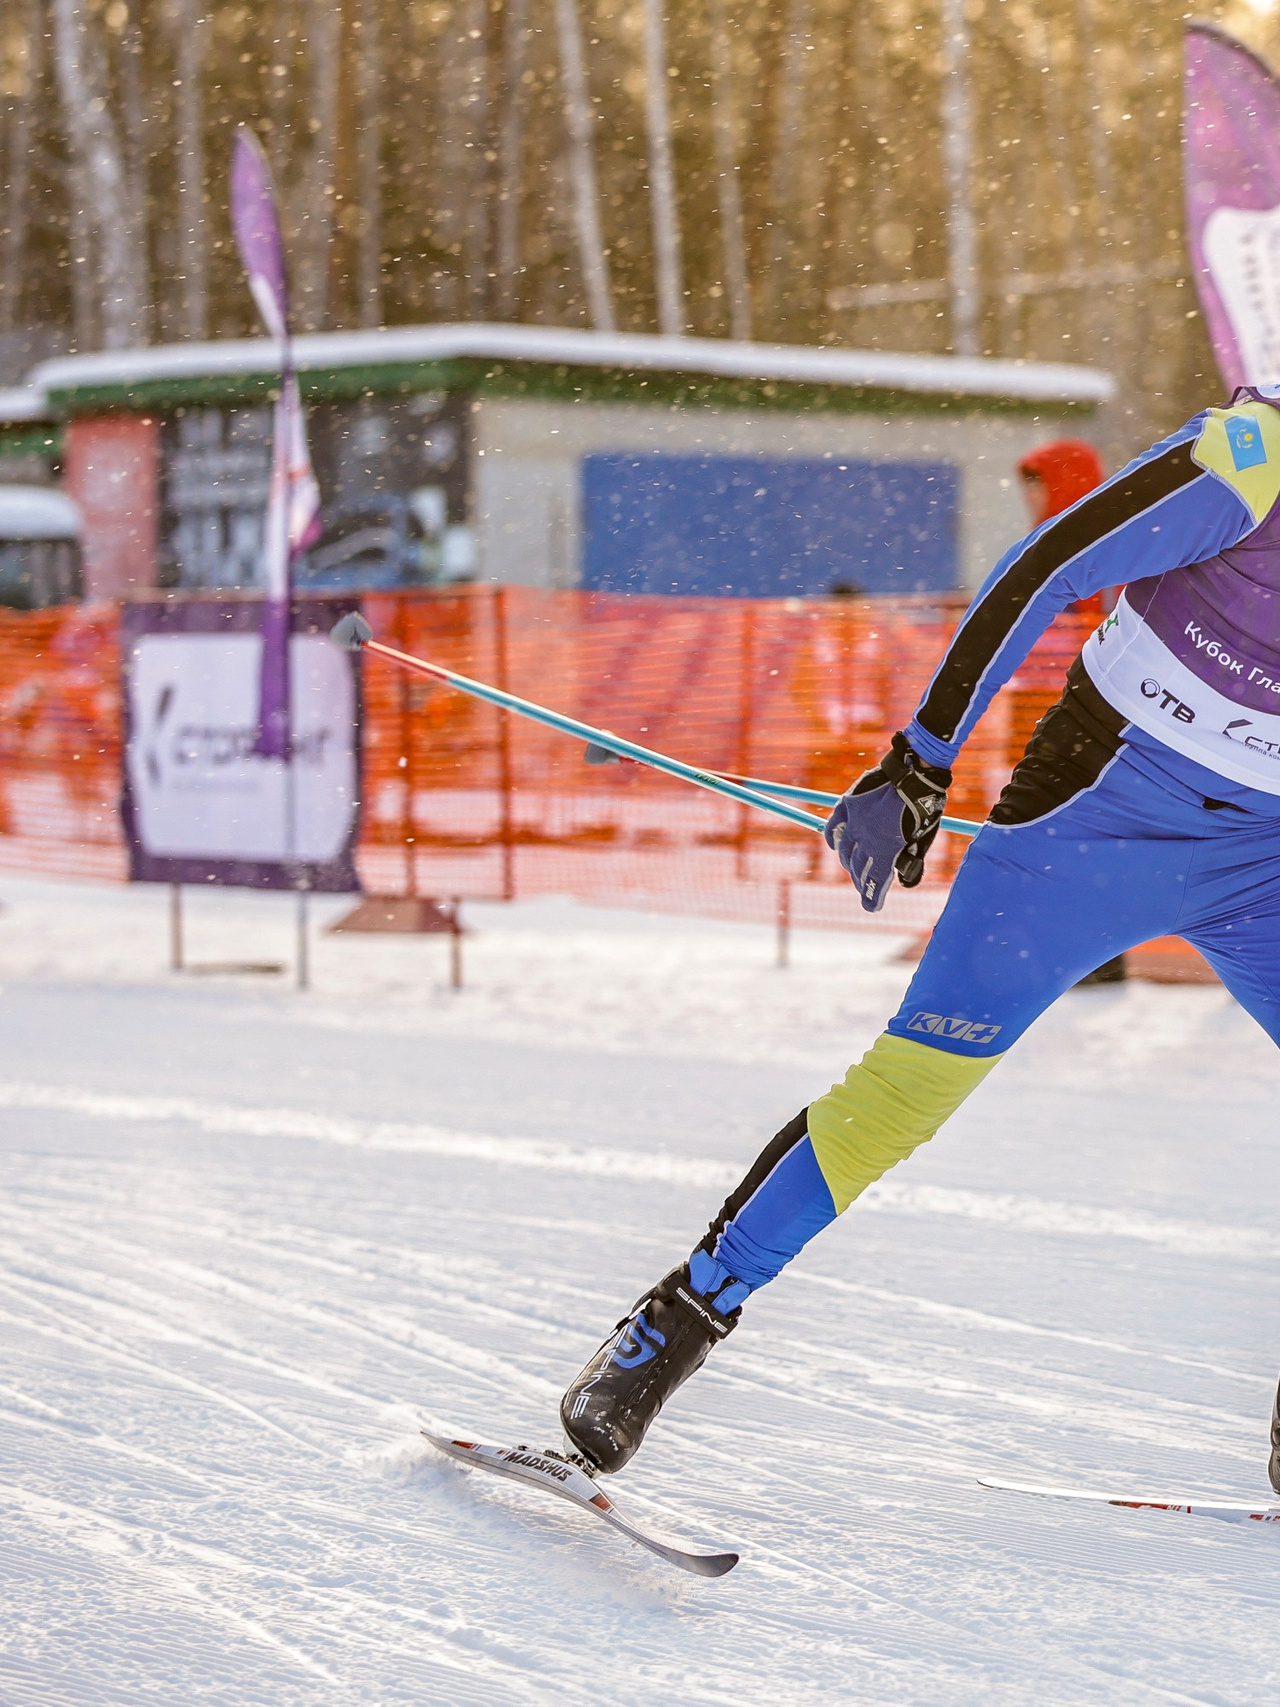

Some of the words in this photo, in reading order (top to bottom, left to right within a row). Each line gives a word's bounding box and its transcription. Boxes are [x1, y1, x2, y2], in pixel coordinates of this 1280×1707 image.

[1184, 620, 1244, 675] Кубок
[676, 1287, 728, 1334] SPINE
[503, 1452, 574, 1482] MADSHUS
